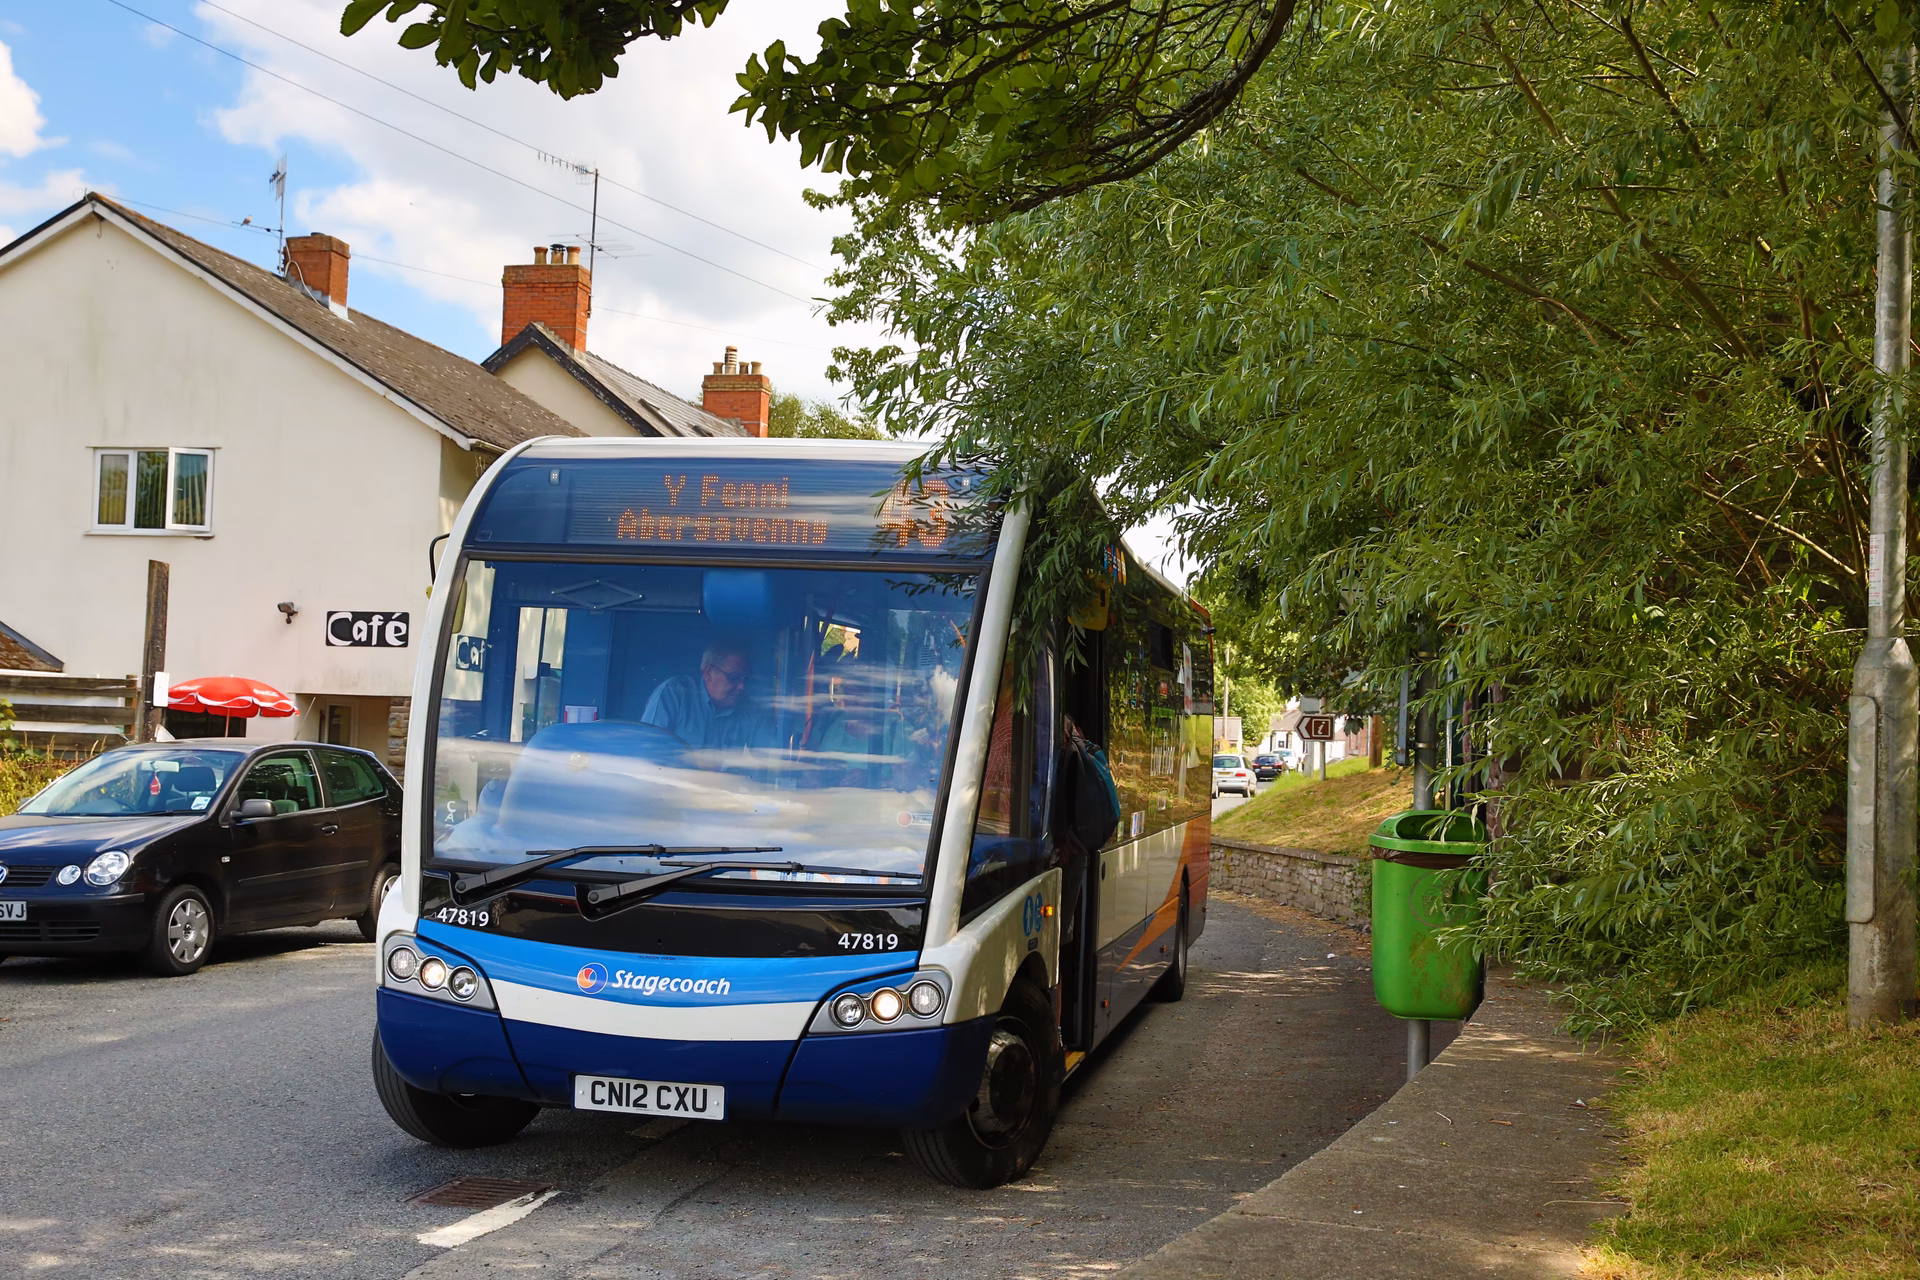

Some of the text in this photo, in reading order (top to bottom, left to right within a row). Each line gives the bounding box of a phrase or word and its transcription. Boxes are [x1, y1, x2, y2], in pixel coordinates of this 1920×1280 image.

[664, 475, 789, 508] Y Fenni
[617, 507, 828, 544] Abergavenny
[882, 478, 948, 547] 43
[327, 611, 407, 647] Café
[437, 907, 490, 927] 47819
[837, 932, 899, 951] 47819
[611, 969, 731, 996] Stagecoach
[656, 1085, 708, 1113] CXU
